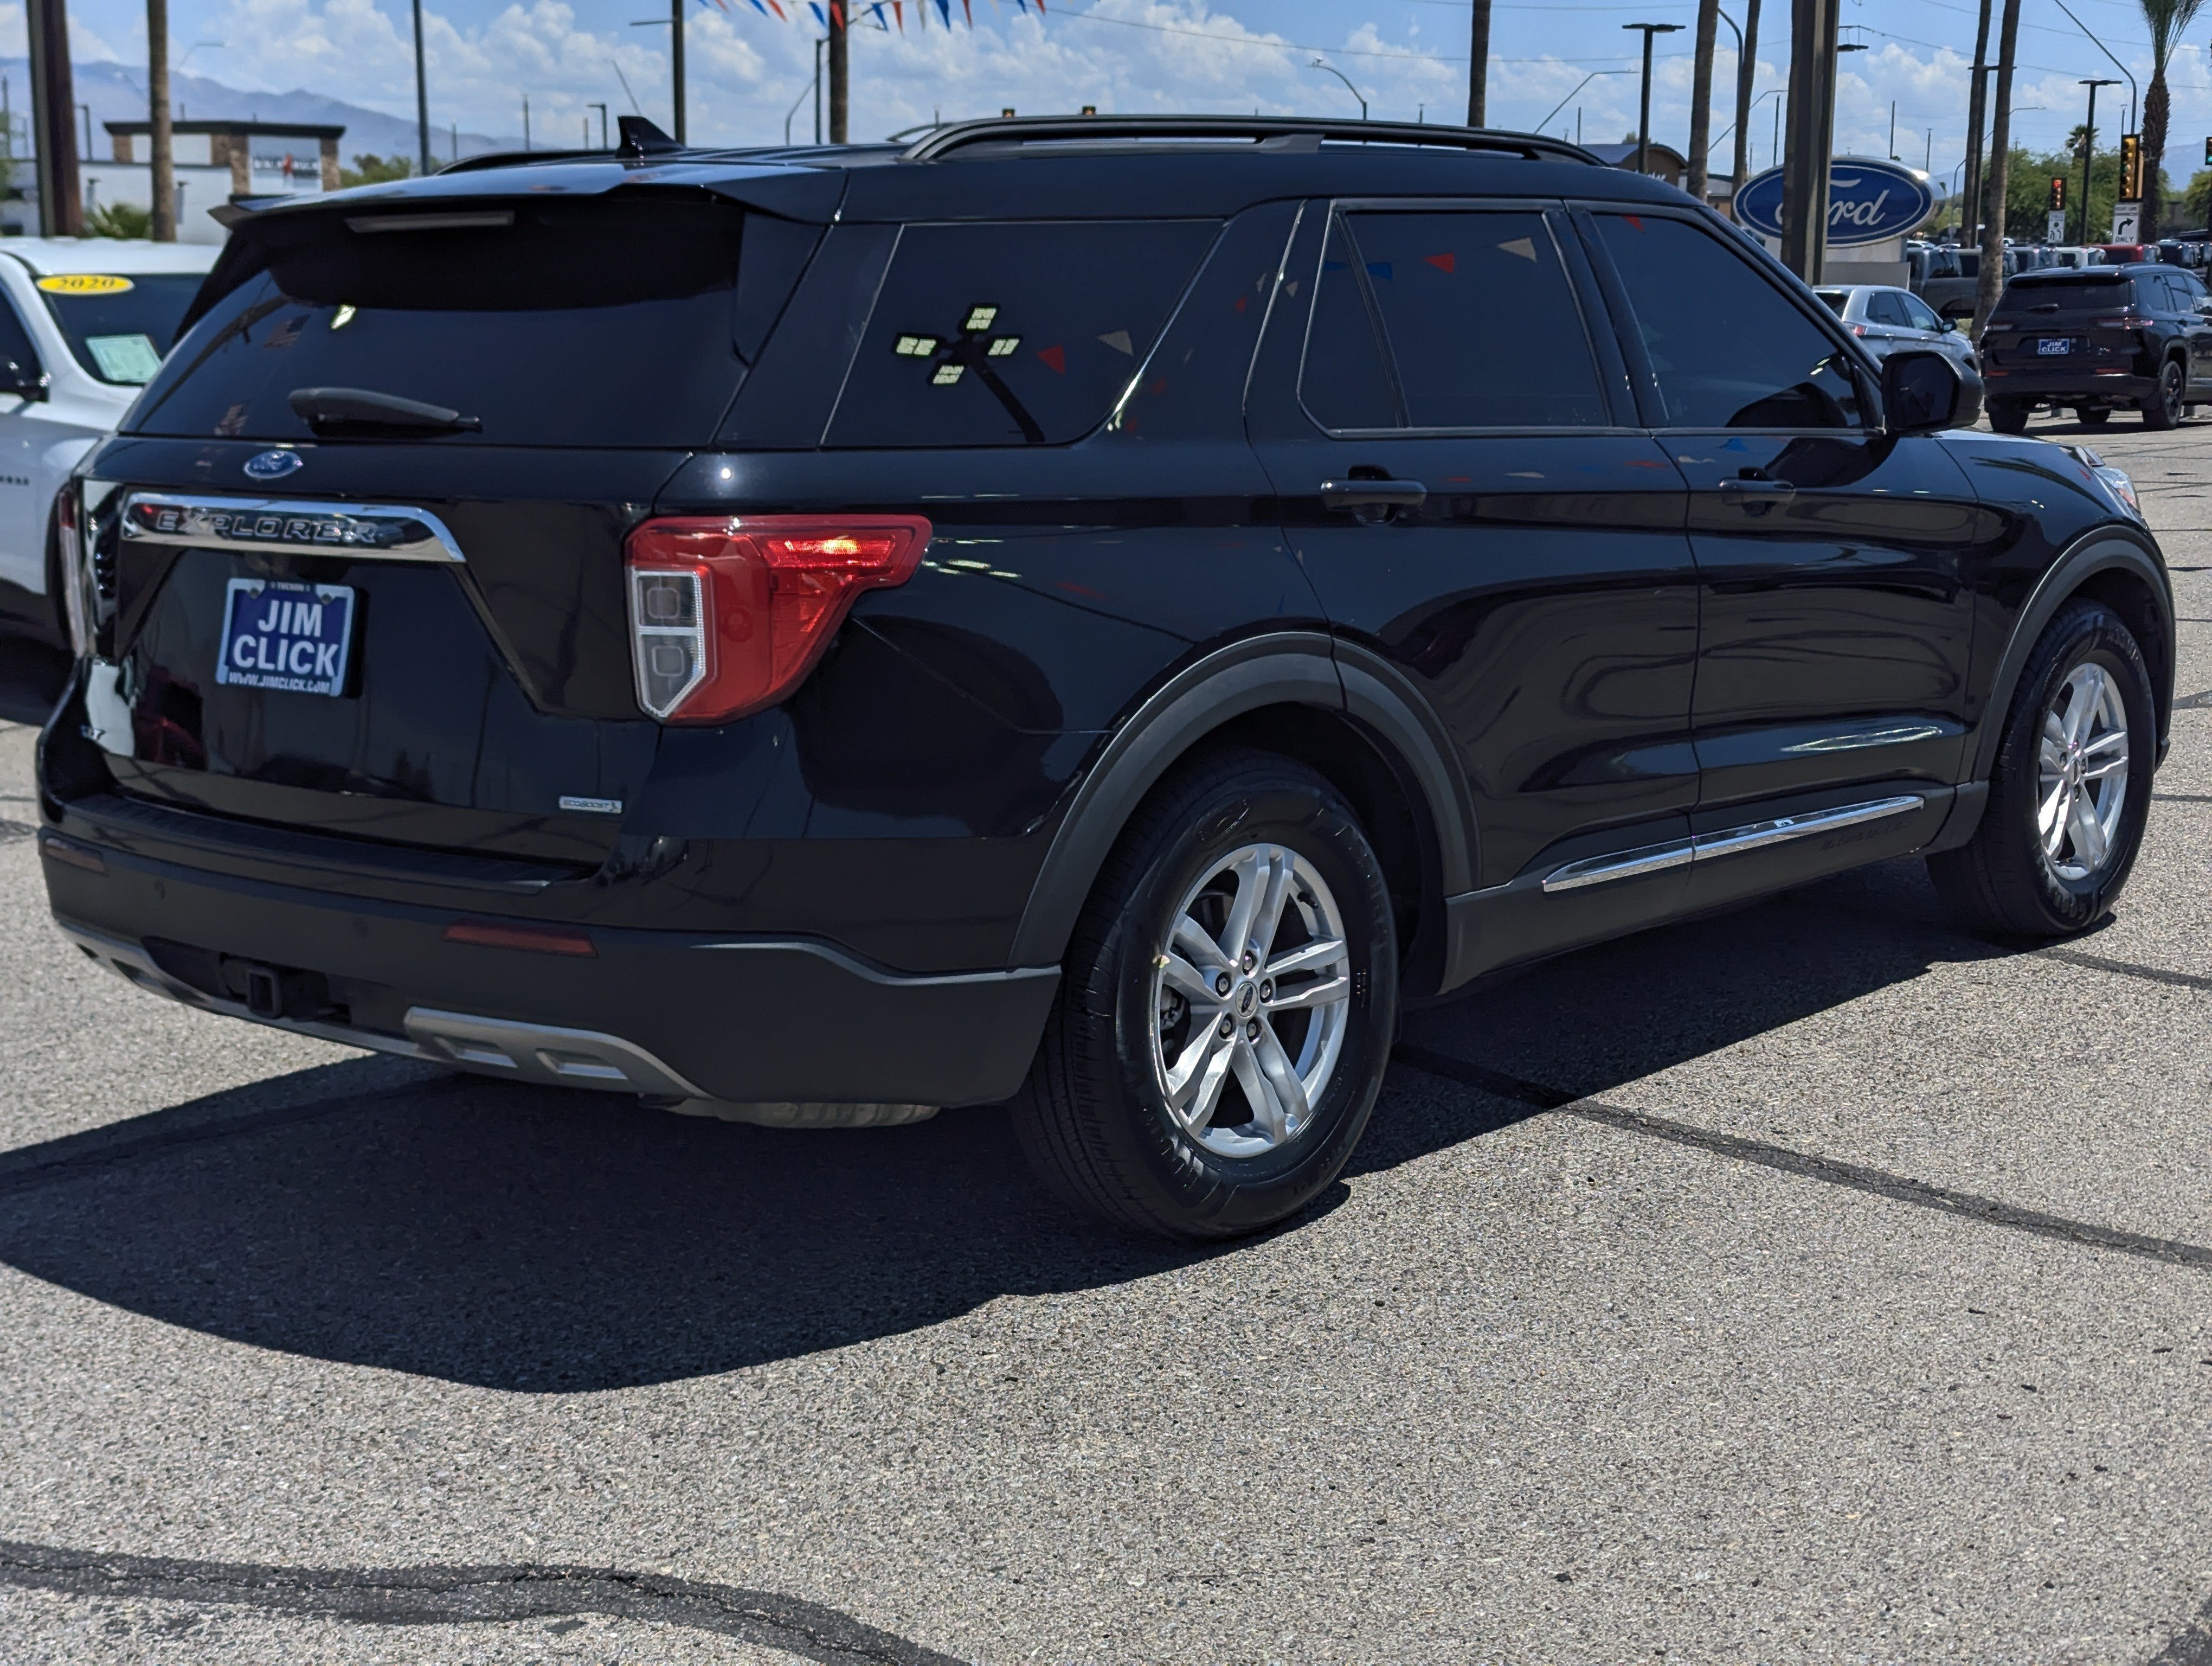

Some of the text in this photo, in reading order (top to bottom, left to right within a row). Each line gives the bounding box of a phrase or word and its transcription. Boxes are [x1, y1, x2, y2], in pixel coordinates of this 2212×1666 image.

[56, 277, 115, 290] 2020
[156, 509, 378, 543] EXPLORER
[258, 599, 323, 638] JIM
[233, 634, 339, 678] CLICK
[228, 671, 331, 694] WWW.JIMCLICK.COM
